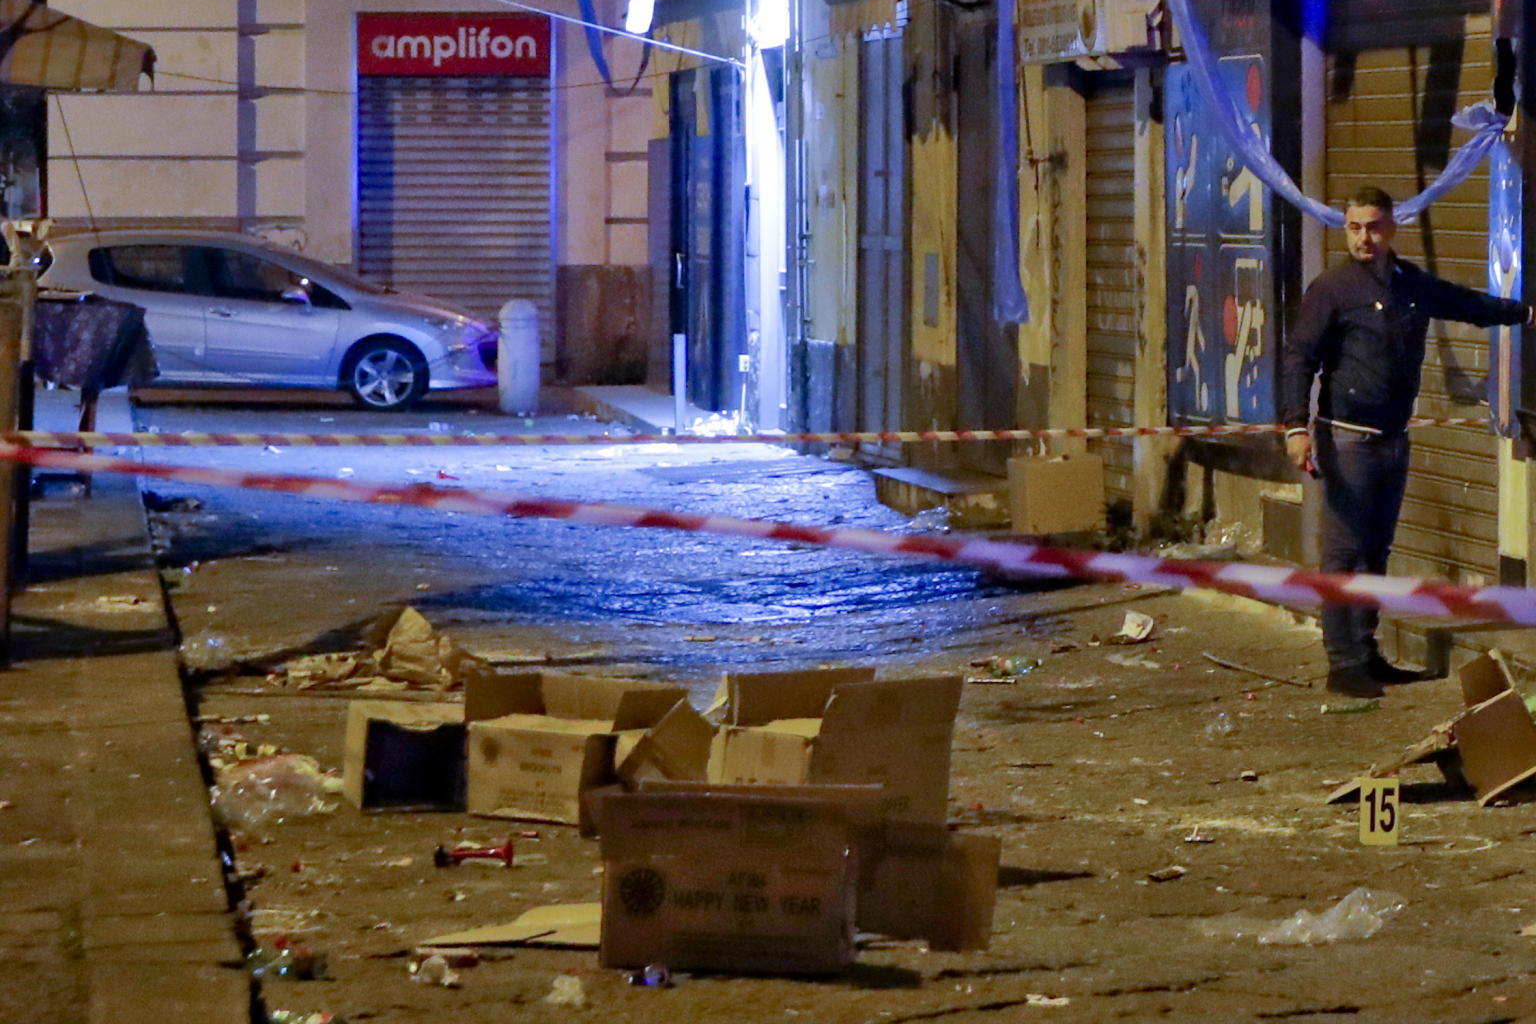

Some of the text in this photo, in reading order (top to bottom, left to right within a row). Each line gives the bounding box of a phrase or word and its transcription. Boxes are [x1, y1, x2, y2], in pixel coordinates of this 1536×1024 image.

[371, 26, 537, 67] amplifon
[1364, 787, 1396, 833] 15
[780, 894, 823, 916] YEAR
